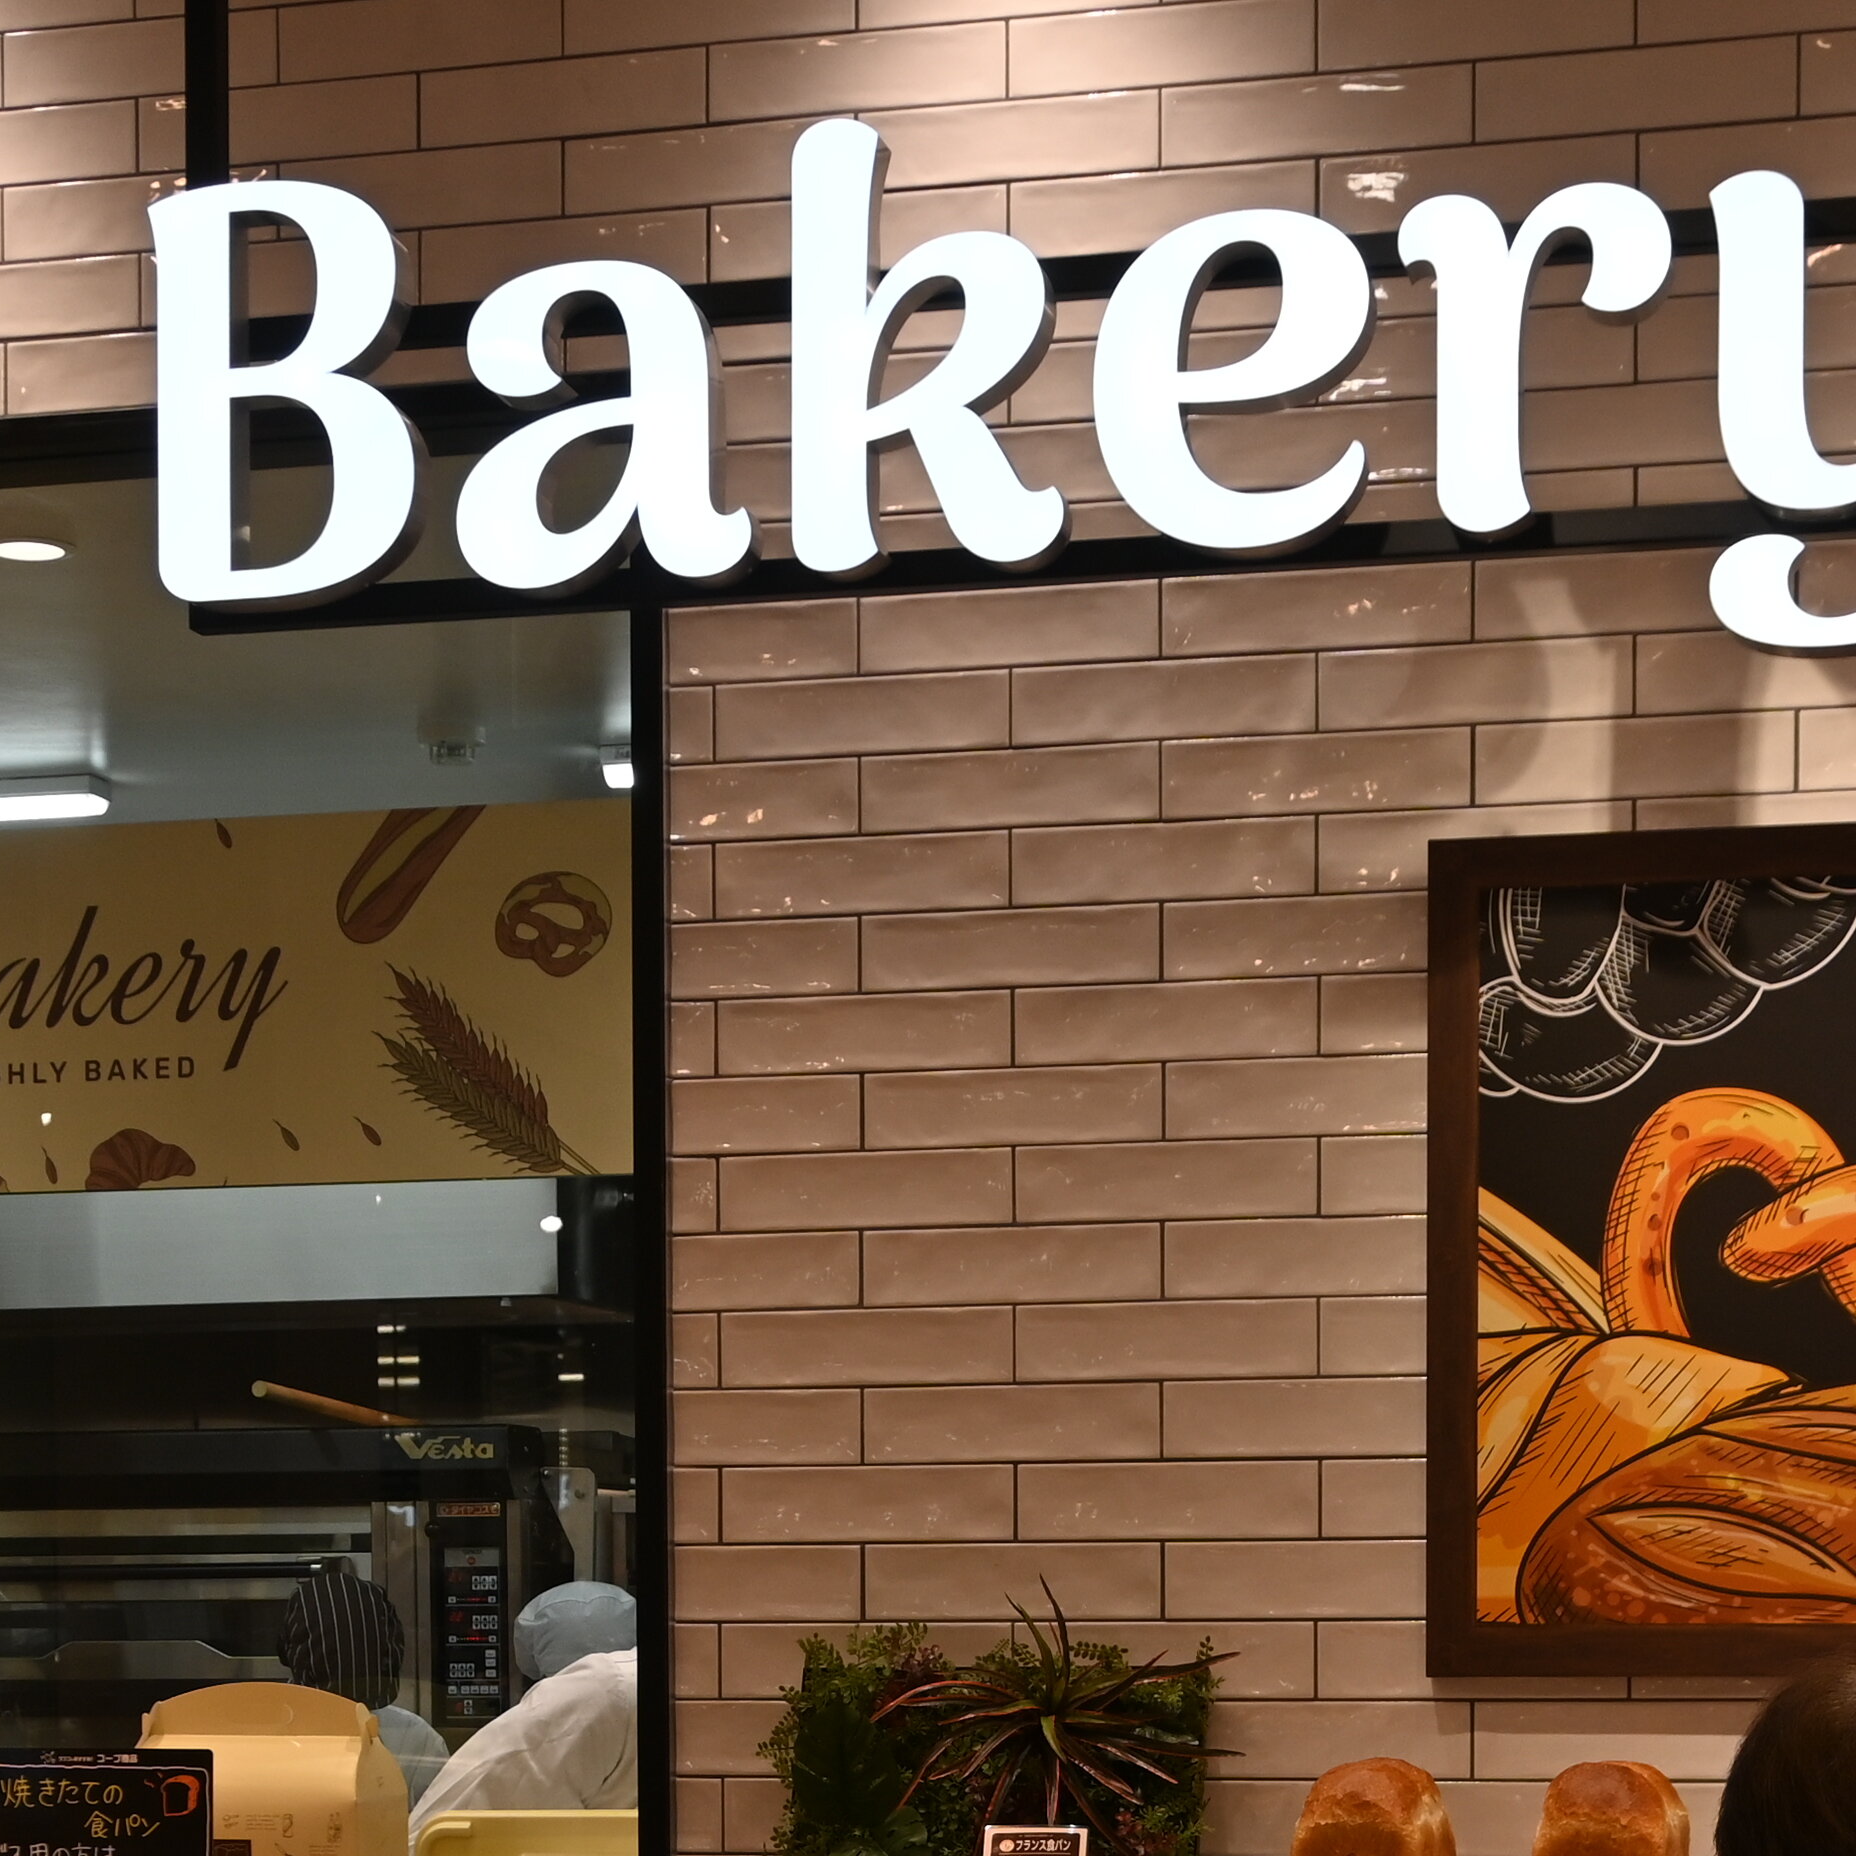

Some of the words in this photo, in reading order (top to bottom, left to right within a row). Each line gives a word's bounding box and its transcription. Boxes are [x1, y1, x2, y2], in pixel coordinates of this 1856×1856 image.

[84, 1054, 198, 1084] BAKED
[0, 1774, 124, 1808] 焼きたての
[84, 1810, 160, 1840] 食パン
[1014, 1838, 1072, 1852] フランス食パン
